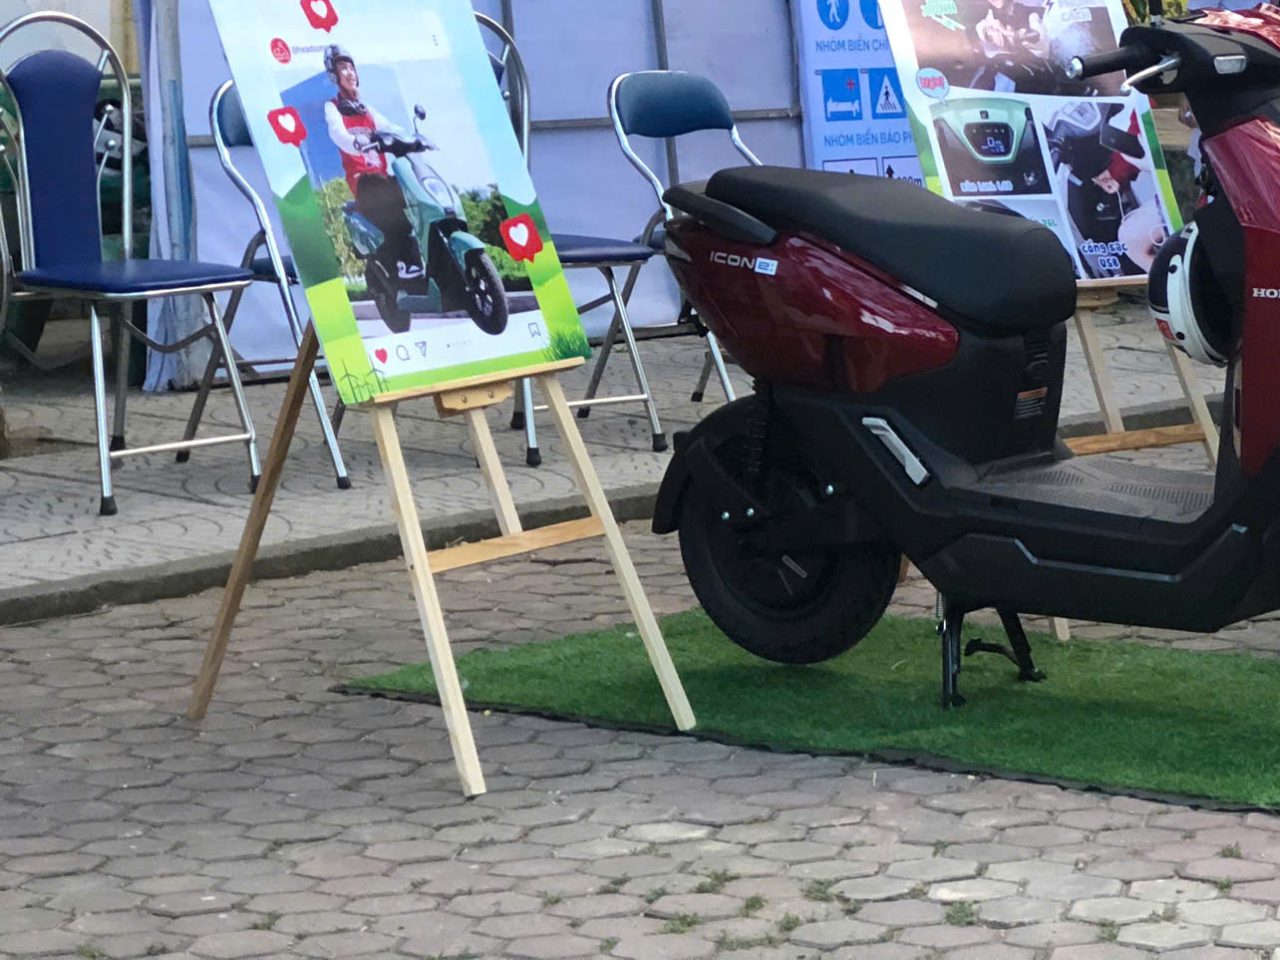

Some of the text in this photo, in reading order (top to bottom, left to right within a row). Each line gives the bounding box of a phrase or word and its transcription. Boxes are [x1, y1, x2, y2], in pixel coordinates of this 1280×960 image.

[815, 37, 846, 52] NHÓM
[824, 131, 854, 147] NHÓM
[709, 251, 755, 269] ICON
[1099, 257, 1120, 269] USB
